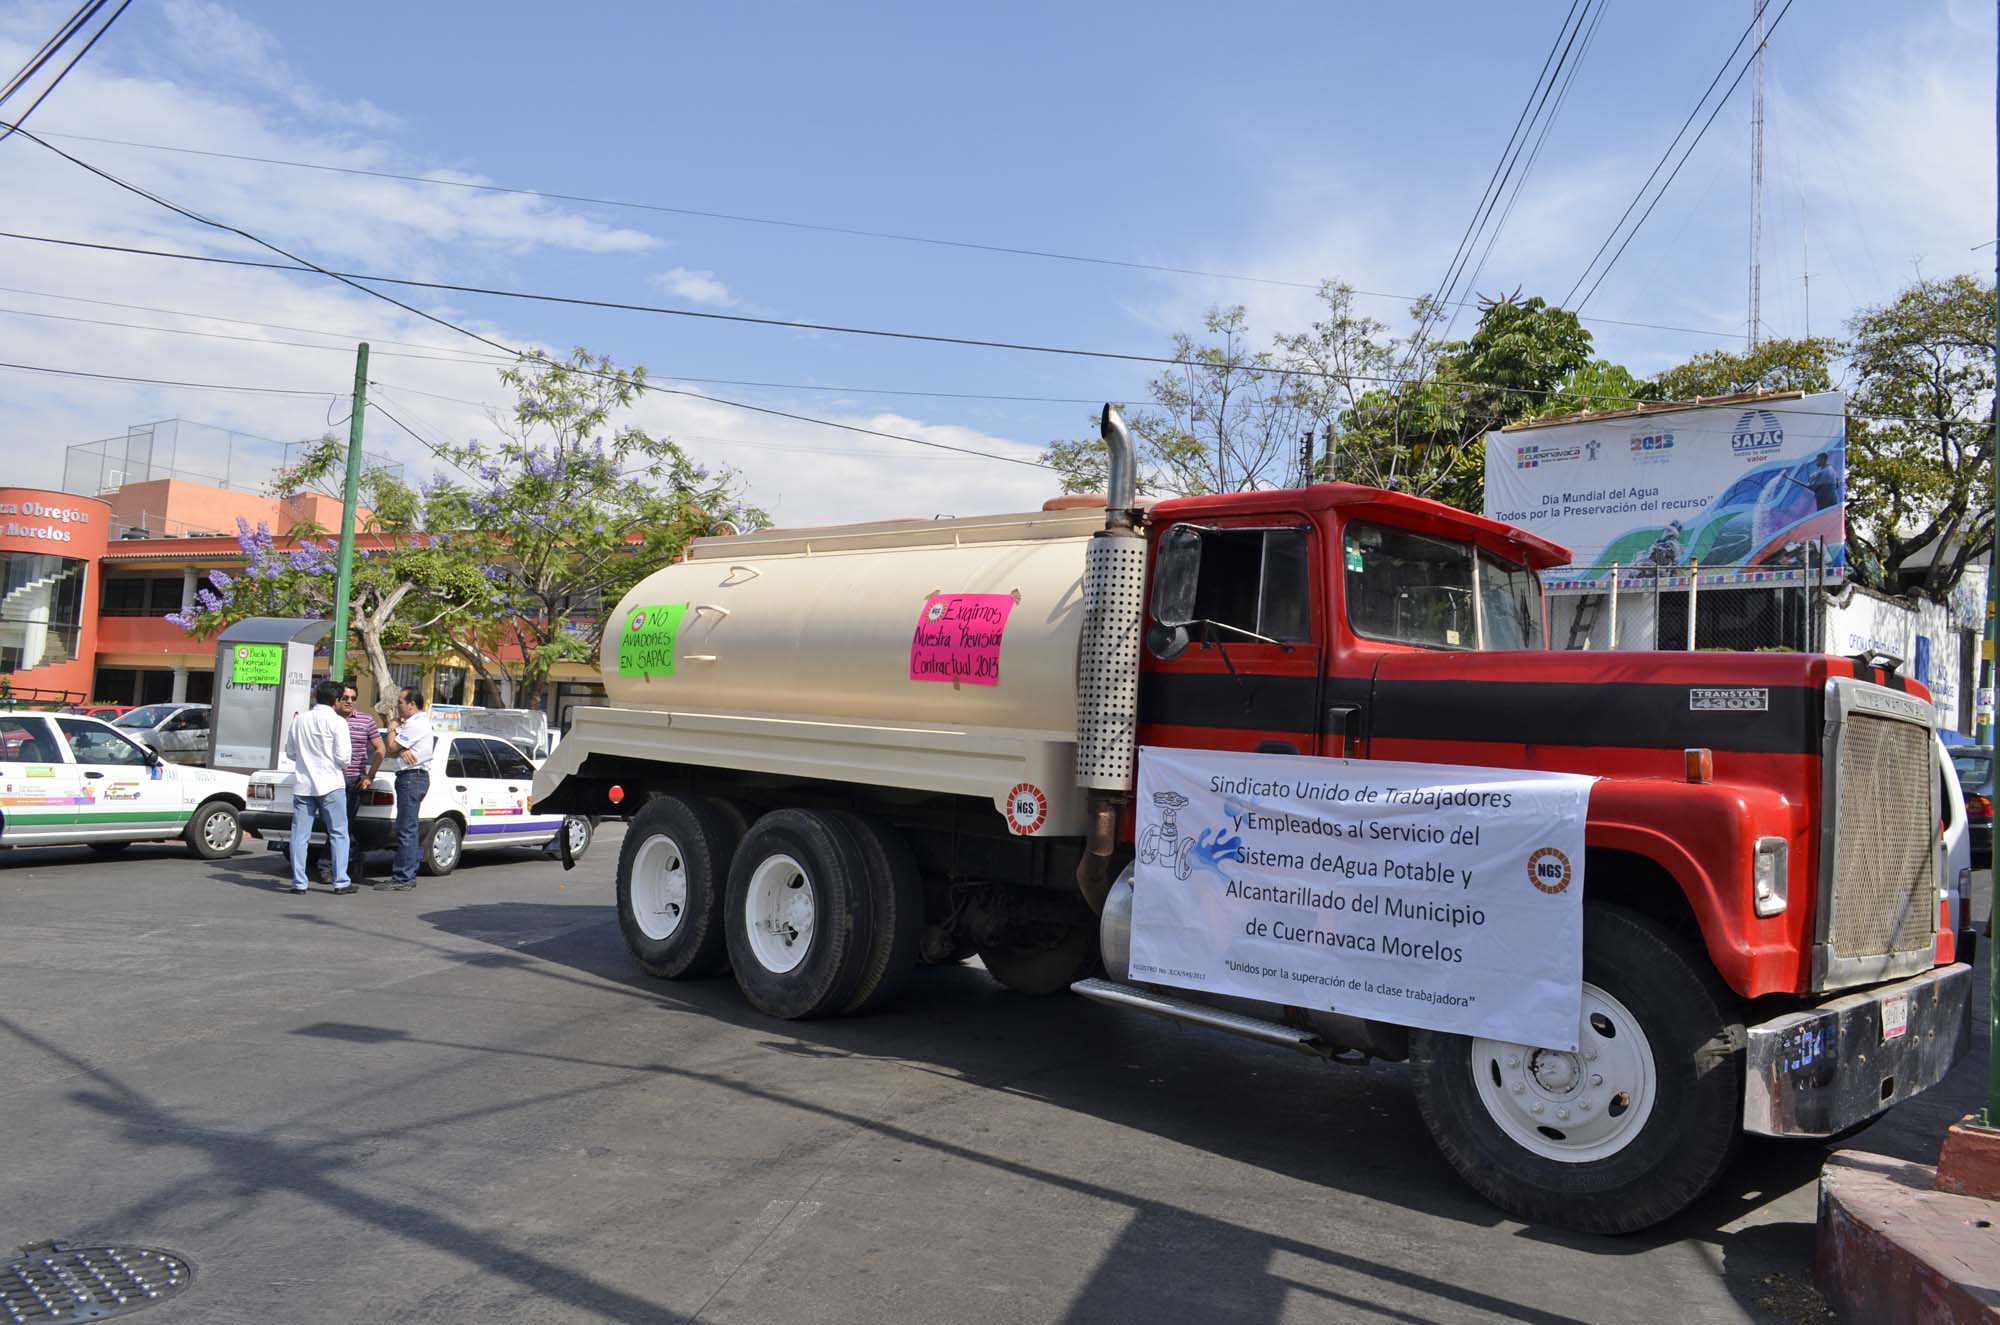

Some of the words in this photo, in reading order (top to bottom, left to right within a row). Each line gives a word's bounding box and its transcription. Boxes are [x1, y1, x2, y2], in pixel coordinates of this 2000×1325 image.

[1733, 430, 1781, 448] SAPAC
[1562, 490, 1605, 504] Mundial
[1609, 488, 1626, 500] del
[1628, 487, 1659, 500] Agua
[22, 502, 89, 523] Obregón
[1496, 510, 1527, 521] Todos
[1530, 509, 1548, 521] por
[1551, 507, 1560, 517] la
[1563, 502, 1637, 516] Preservación
[1640, 501, 1658, 511] del
[8, 523, 71, 542] Morelos
[648, 608, 669, 627] NO
[914, 623, 951, 647] Nuestra
[620, 655, 633, 669] EN
[637, 649, 672, 669] SAPAC
[913, 651, 971, 676] Contractual
[975, 655, 999, 679] 2013
[1695, 698, 1761, 709] 4300
[1696, 690, 1760, 698] TRANSTAR
[1210, 776, 1290, 798] Sindicato
[1296, 781, 1349, 801] Unido
[1354, 785, 1378, 803] de
[1385, 787, 1512, 810] Trabajadores
[1233, 815, 1243, 832] y
[1248, 812, 1343, 838] Empleados
[1348, 819, 1364, 839] al
[1369, 821, 1445, 844] Servicio
[1450, 825, 1480, 846] del
[1236, 846, 1304, 870] Sistema
[1384, 859, 1455, 884] Potable
[1461, 870, 1473, 889] y
[1538, 863, 1562, 878] NGS
[1225, 880, 1346, 910] Alcantarillado
[1352, 893, 1379, 914] del
[1385, 897, 1485, 927] Municipio
[1246, 917, 1267, 937] de
[1273, 921, 1376, 951] Cuernavaca
[1382, 935, 1463, 963] Morelos
[1262, 967, 1278, 978] por
[1280, 968, 1289, 979] la
[1291, 972, 1345, 988] superación
[1348, 978, 1361, 991] de
[1364, 980, 1374, 993] la
[1376, 984, 1403, 997] clase
